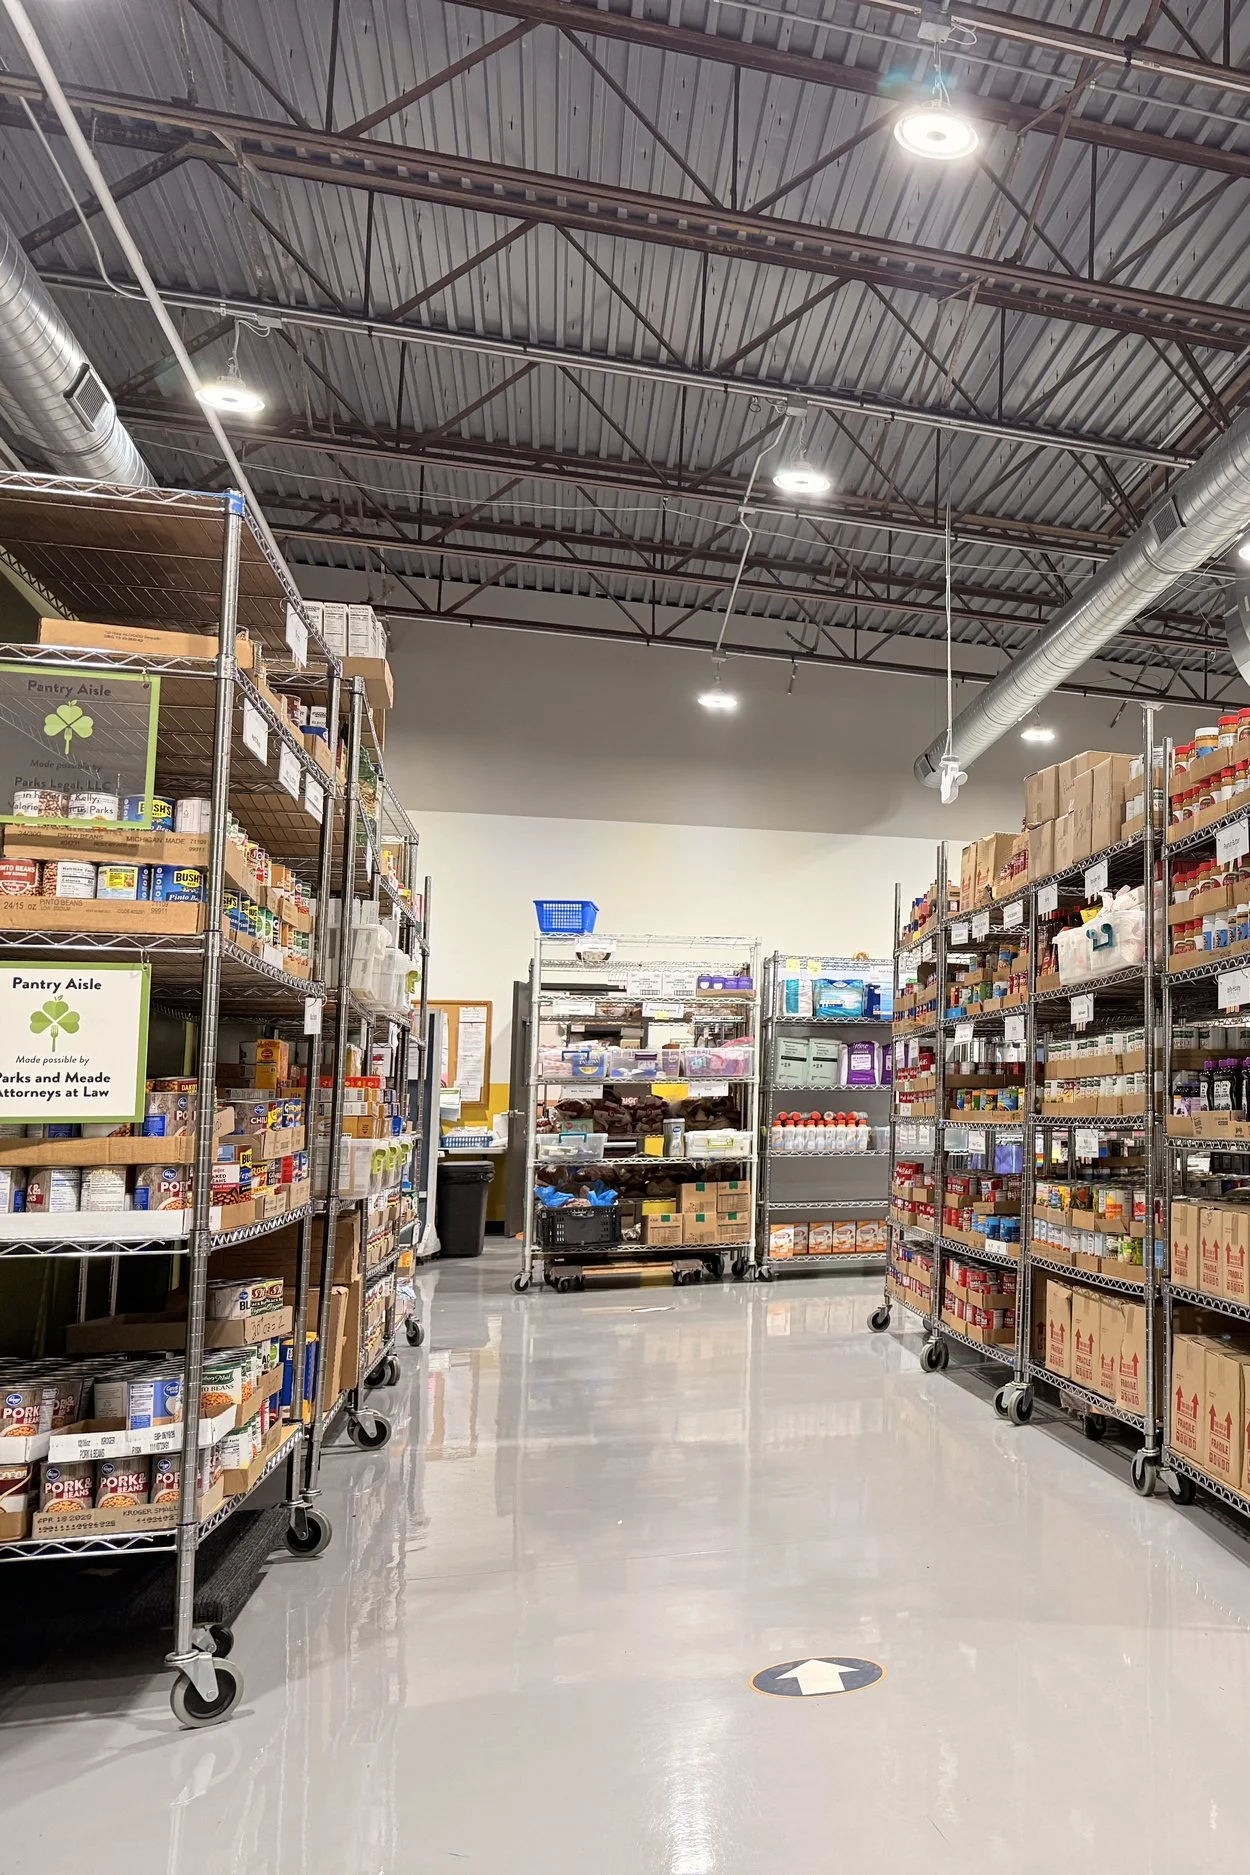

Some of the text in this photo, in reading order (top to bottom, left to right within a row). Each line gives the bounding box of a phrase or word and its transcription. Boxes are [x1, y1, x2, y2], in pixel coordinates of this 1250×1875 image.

[27, 680, 112, 697] Pantry Aisle
[14, 777, 111, 792] Parks Legal, LLC
[90, 805, 114, 814] Parks
[140, 801, 172, 816] BSH'S
[126, 836, 163, 844] MICHIGAN
[4, 902, 24, 910] 24/15
[12, 976, 102, 994] Pantry Aisle
[15, 1056, 90, 1066] Made possible by
[0, 1072, 111, 1083] arks and Meade
[65, 1088, 78, 1098] at
[84, 1086, 109, 1098] Law
[1204, 1263, 1218, 1273] FRAGILE
[1227, 1270, 1243, 1280] FRAGILE
[210, 1384, 235, 1392] BEANS
[3, 1406, 39, 1419] PORK
[24, 1414, 40, 1424] BEAN
[1177, 1418, 1196, 1434] FRAGILE
[1210, 1439, 1229, 1456] FRAGILE
[100, 1475, 138, 1488] PORK
[156, 1473, 180, 1484] POR
[45, 1480, 84, 1494] PORK
[117, 1484, 144, 1494] BEANS
[63, 1488, 90, 1498] BEANS
[123, 1506, 180, 1516] KROGER SMALL
